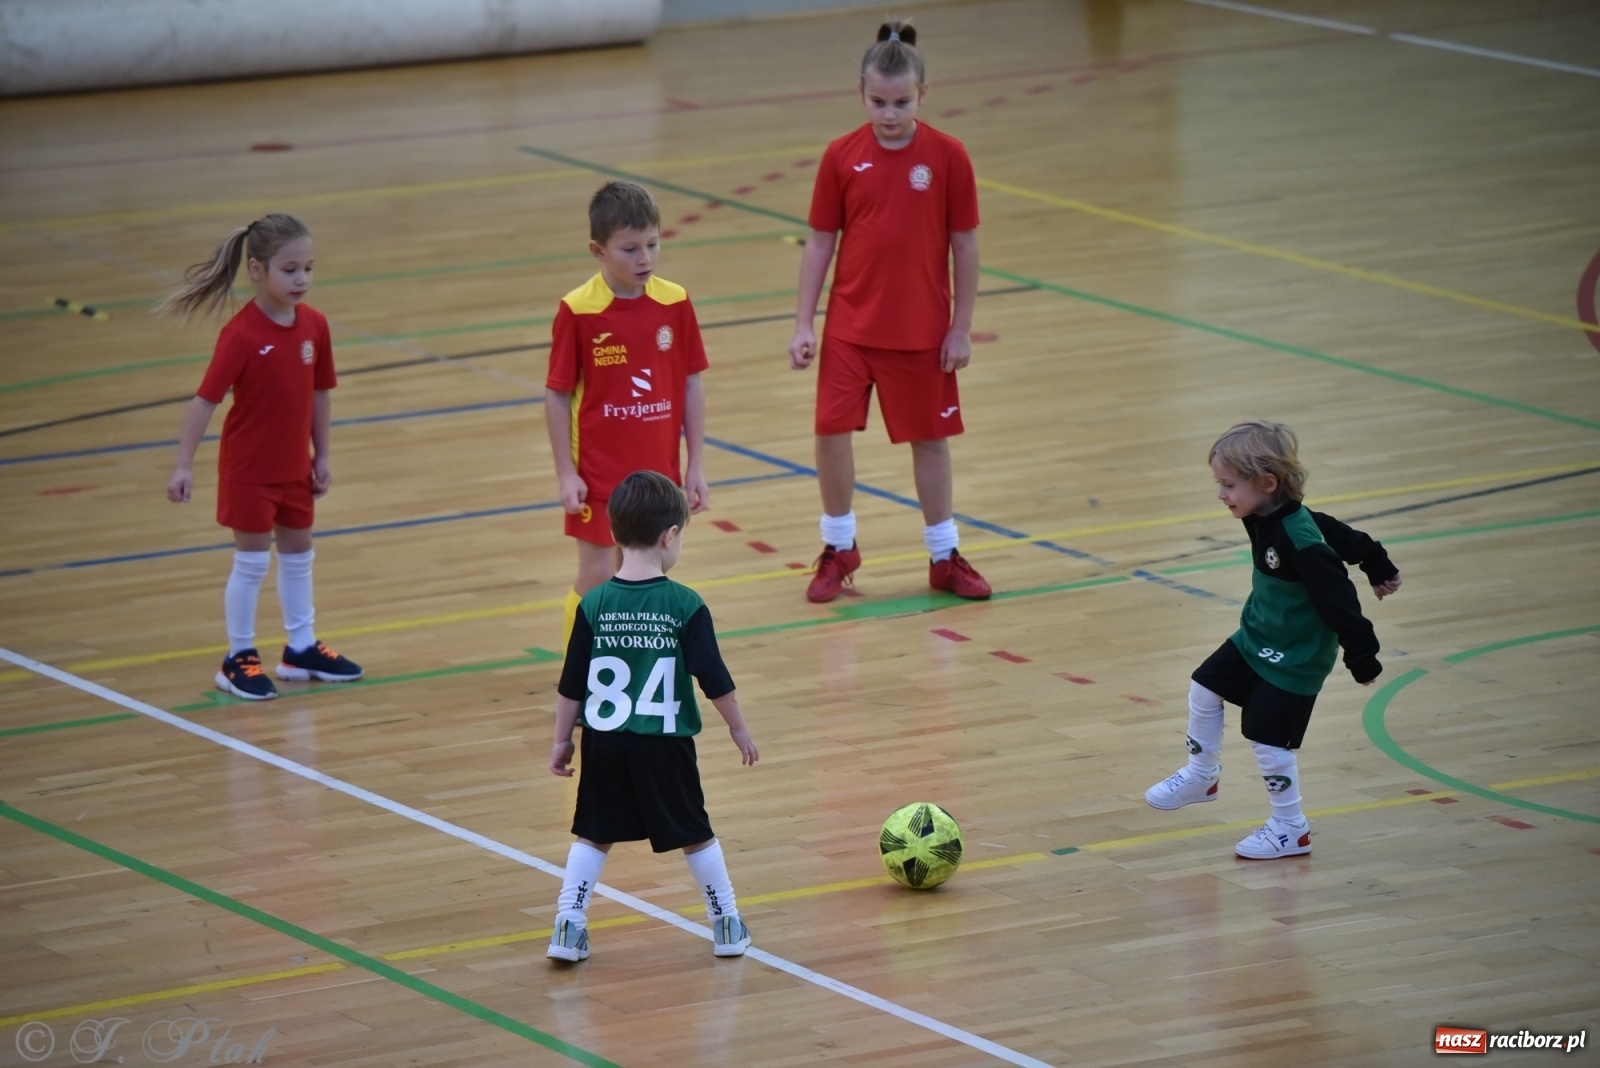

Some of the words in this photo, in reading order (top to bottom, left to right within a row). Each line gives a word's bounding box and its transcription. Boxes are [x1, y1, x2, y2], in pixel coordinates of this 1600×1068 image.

[592, 345, 628, 357] GMINA
[603, 399, 672, 420] Fryzjernia
[581, 504, 593, 523] 9
[599, 623, 647, 632] MŁODEGO
[594, 633, 678, 650] TWORKÓW
[1258, 647, 1285, 663] 93
[584, 655, 682, 734] 84
